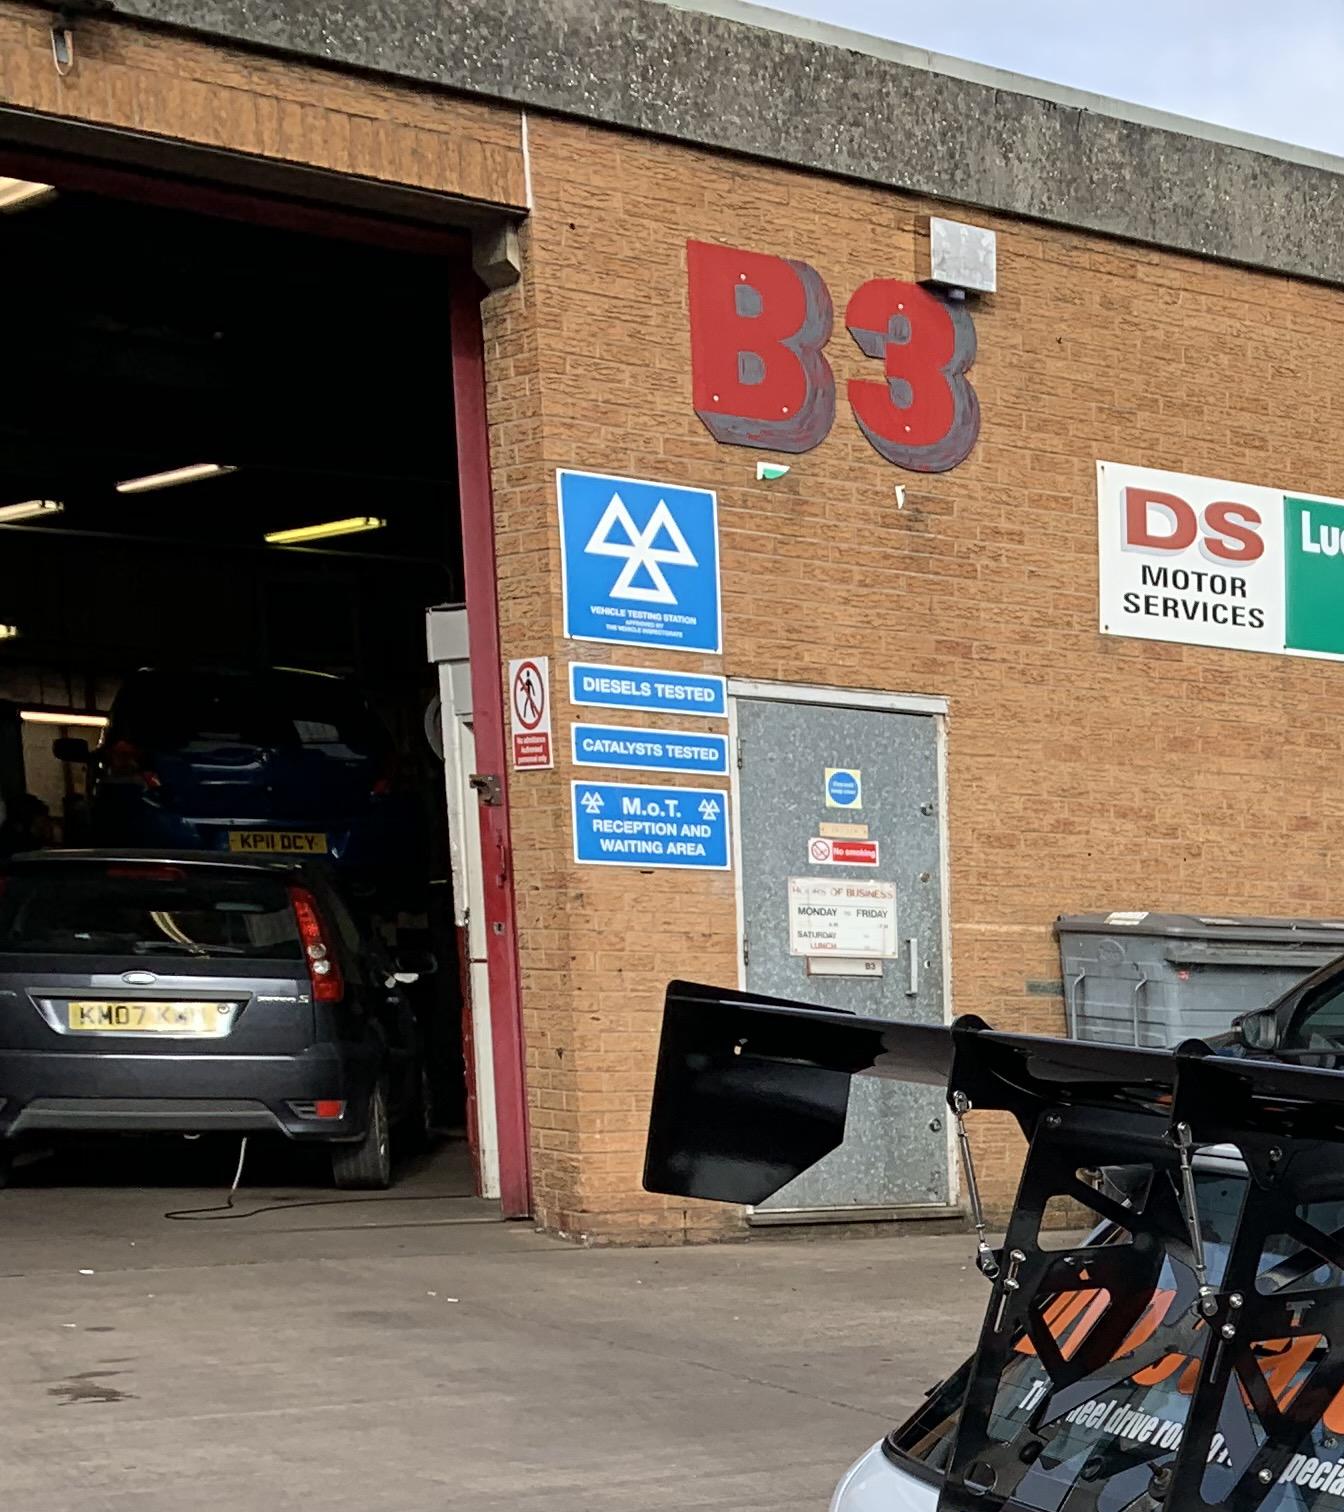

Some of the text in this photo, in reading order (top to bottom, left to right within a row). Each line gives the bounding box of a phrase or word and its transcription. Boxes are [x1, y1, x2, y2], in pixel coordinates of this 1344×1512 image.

[687, 240, 981, 473] B3
[1121, 486, 1265, 566] DS
[1141, 565, 1246, 598] MOTOR
[590, 605, 697, 626] VEHICLE TESTING STATION
[1123, 592, 1265, 628] SERVICES
[583, 677, 715, 702] DIESELS TESTED
[583, 739, 719, 761] CATALYSTS TESTED
[622, 797, 682, 818] M.o.T.
[593, 819, 711, 838] RECEPTION AND
[600, 839, 706, 856] WAITING AREA
[846, 888, 893, 899] BUSINESS
[798, 907, 837, 916] MONDAY
[856, 908, 888, 918] FRIDAY
[797, 930, 837, 939] SATURDAY
[79, 1006, 148, 1025] KM07
[1105, 1400, 1160, 1444] drive
